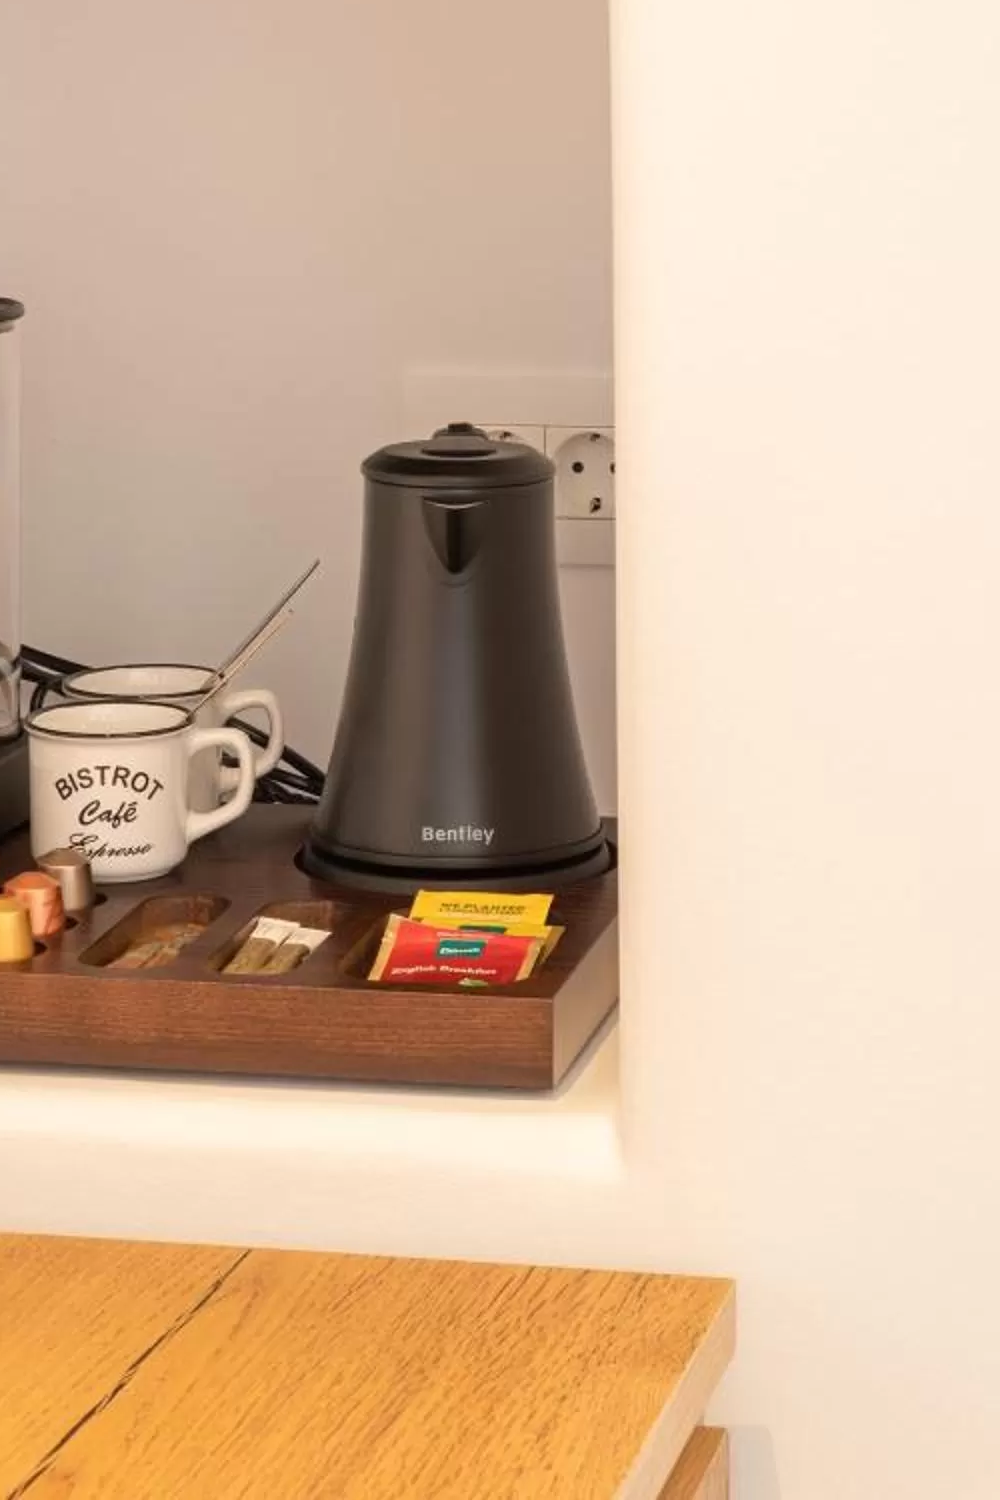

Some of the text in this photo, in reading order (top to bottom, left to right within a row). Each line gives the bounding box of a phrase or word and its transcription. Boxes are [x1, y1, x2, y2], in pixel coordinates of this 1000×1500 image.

[55, 765, 164, 800] BISTROT
[78, 799, 138, 829] Café
[68, 832, 153, 860] Espresso
[422, 825, 495, 846] Bentley
